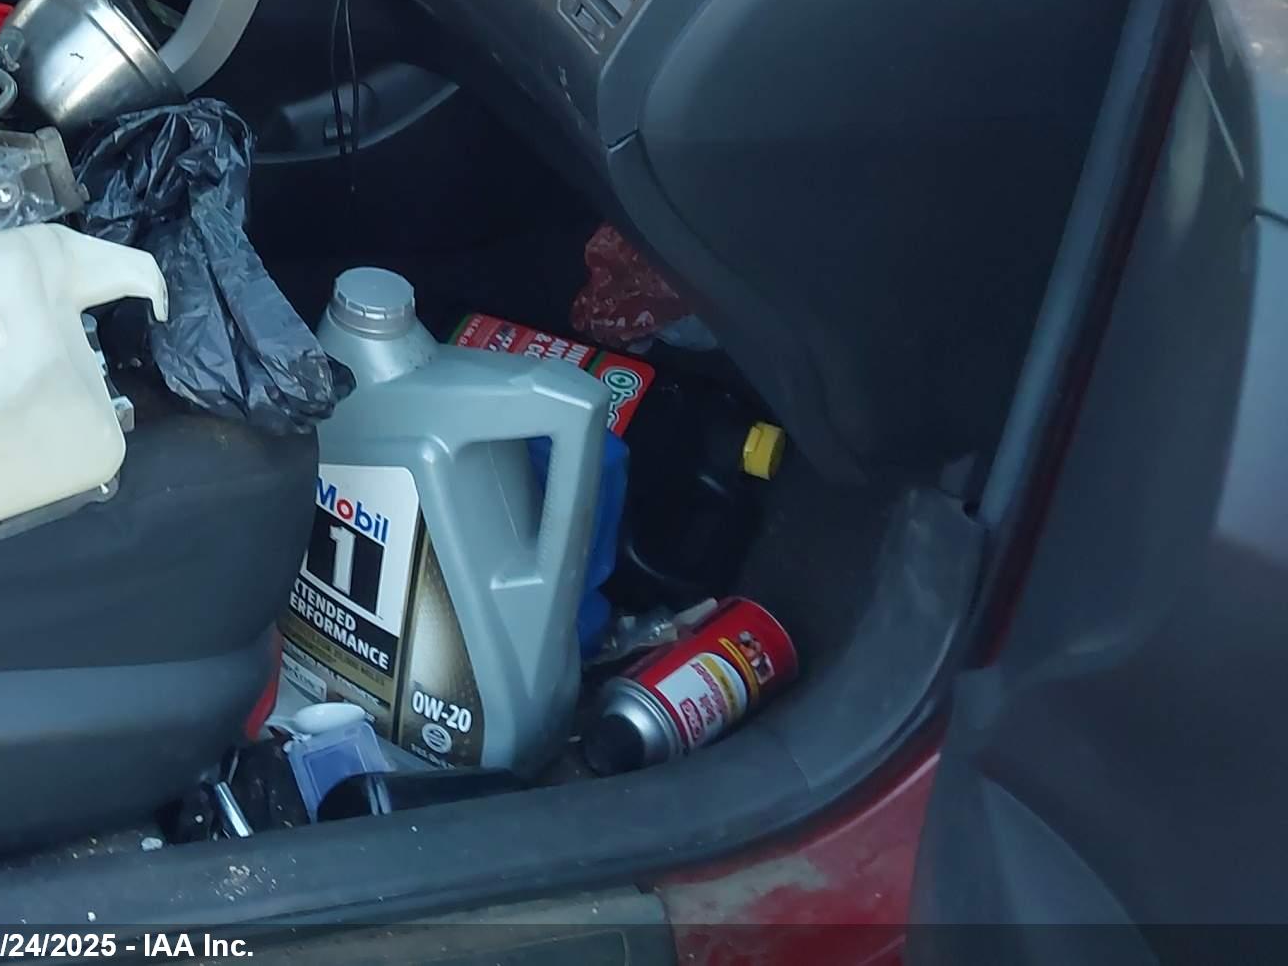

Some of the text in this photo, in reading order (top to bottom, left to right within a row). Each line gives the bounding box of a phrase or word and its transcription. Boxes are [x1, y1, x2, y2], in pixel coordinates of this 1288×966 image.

[316, 477, 389, 544] Mobil
[329, 525, 357, 594] 1
[289, 591, 390, 671] ERFORMANCE
[294, 577, 357, 631] XTENDED
[412, 690, 472, 733] 0W-20
